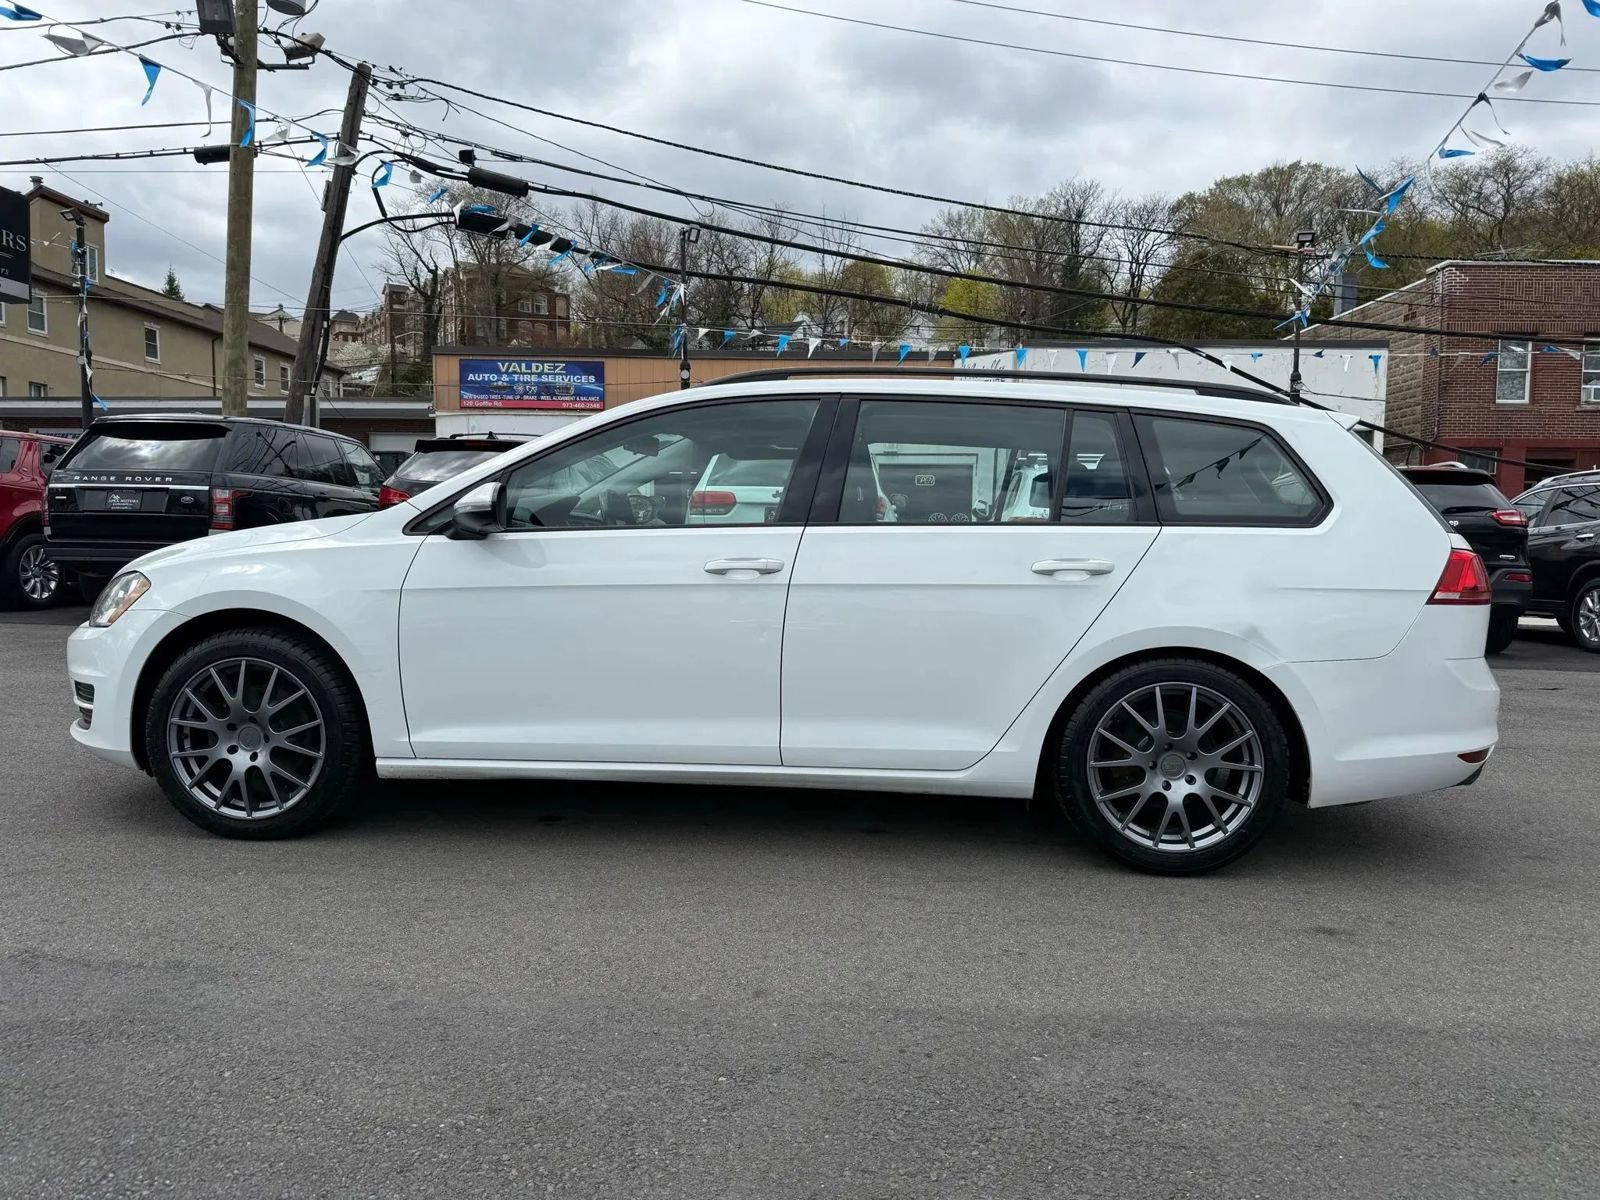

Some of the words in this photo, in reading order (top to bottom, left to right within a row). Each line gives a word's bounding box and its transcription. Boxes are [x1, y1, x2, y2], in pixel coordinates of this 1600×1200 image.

[497, 362, 566, 373] VALDEZ
[467, 373, 498, 381] AUTO
[512, 374, 538, 382] TIRE
[541, 375, 596, 383] SERVICES
